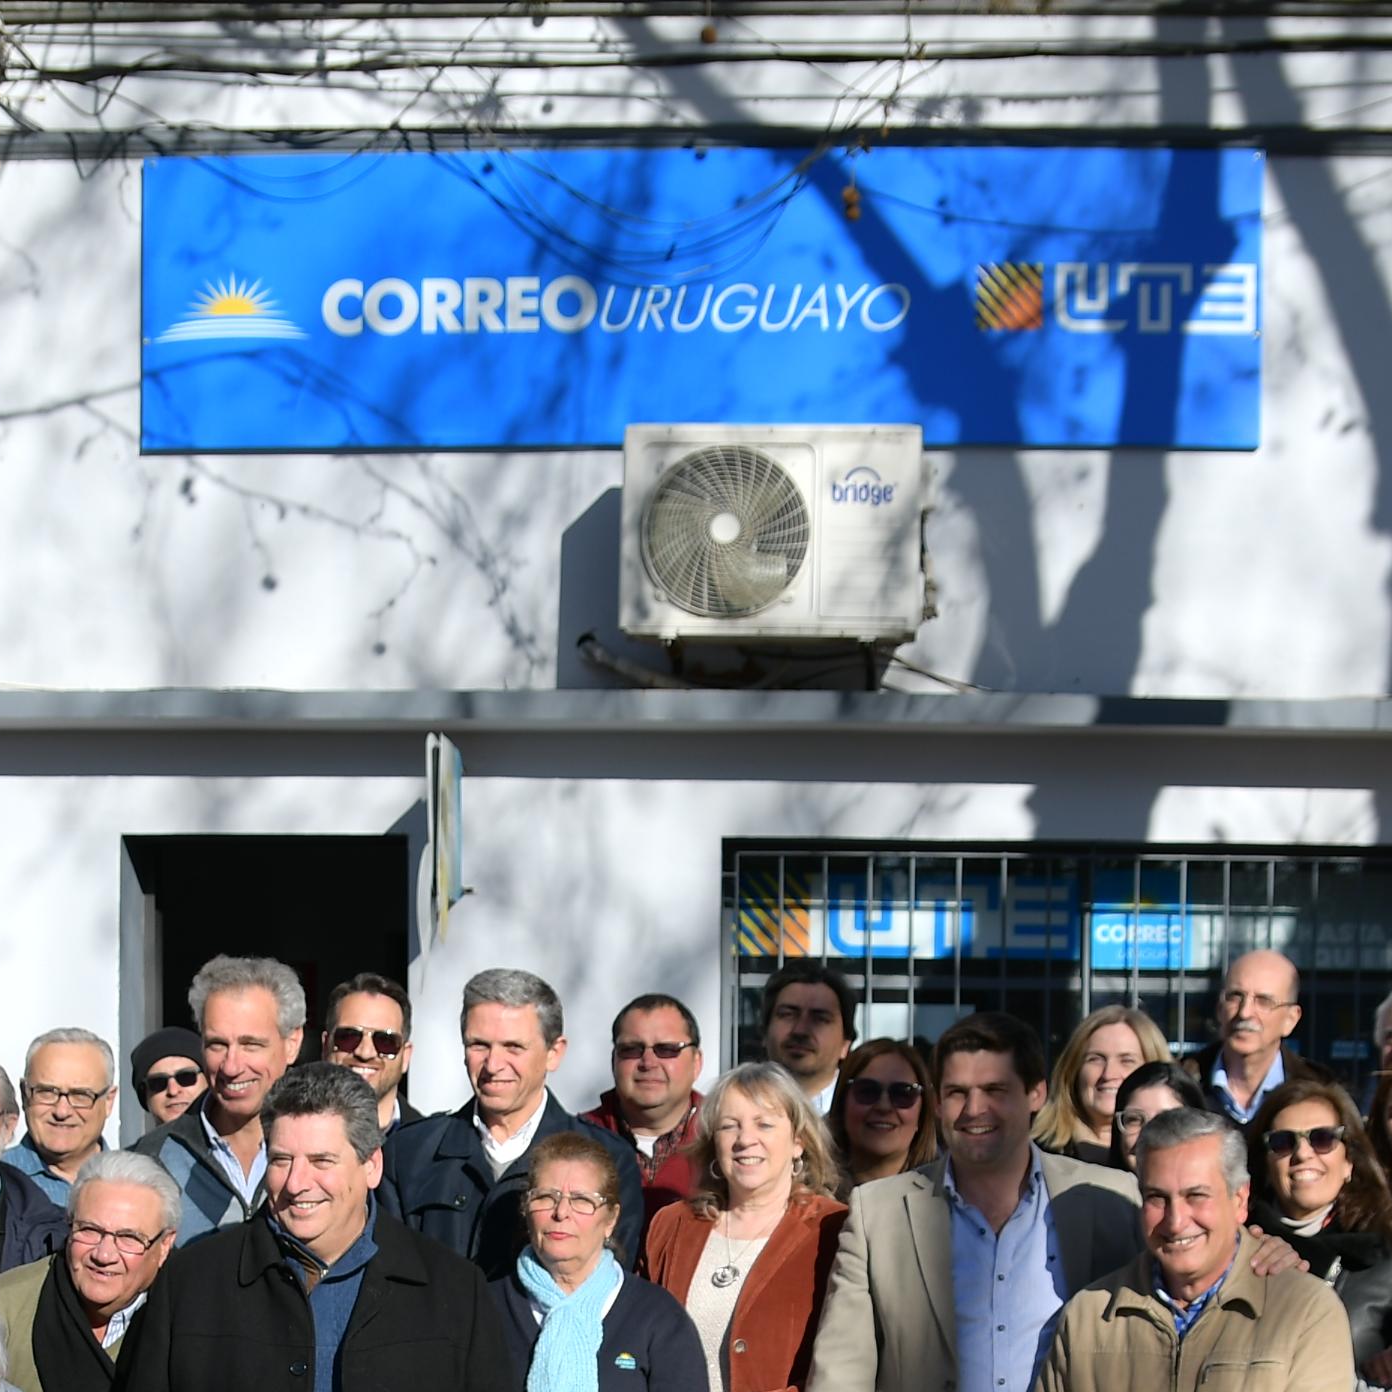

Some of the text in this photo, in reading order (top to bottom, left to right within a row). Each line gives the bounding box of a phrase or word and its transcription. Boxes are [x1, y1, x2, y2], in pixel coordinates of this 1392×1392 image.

[321, 276, 911, 336] CORREO URUGUAYO
[831, 482, 894, 506] bridge
